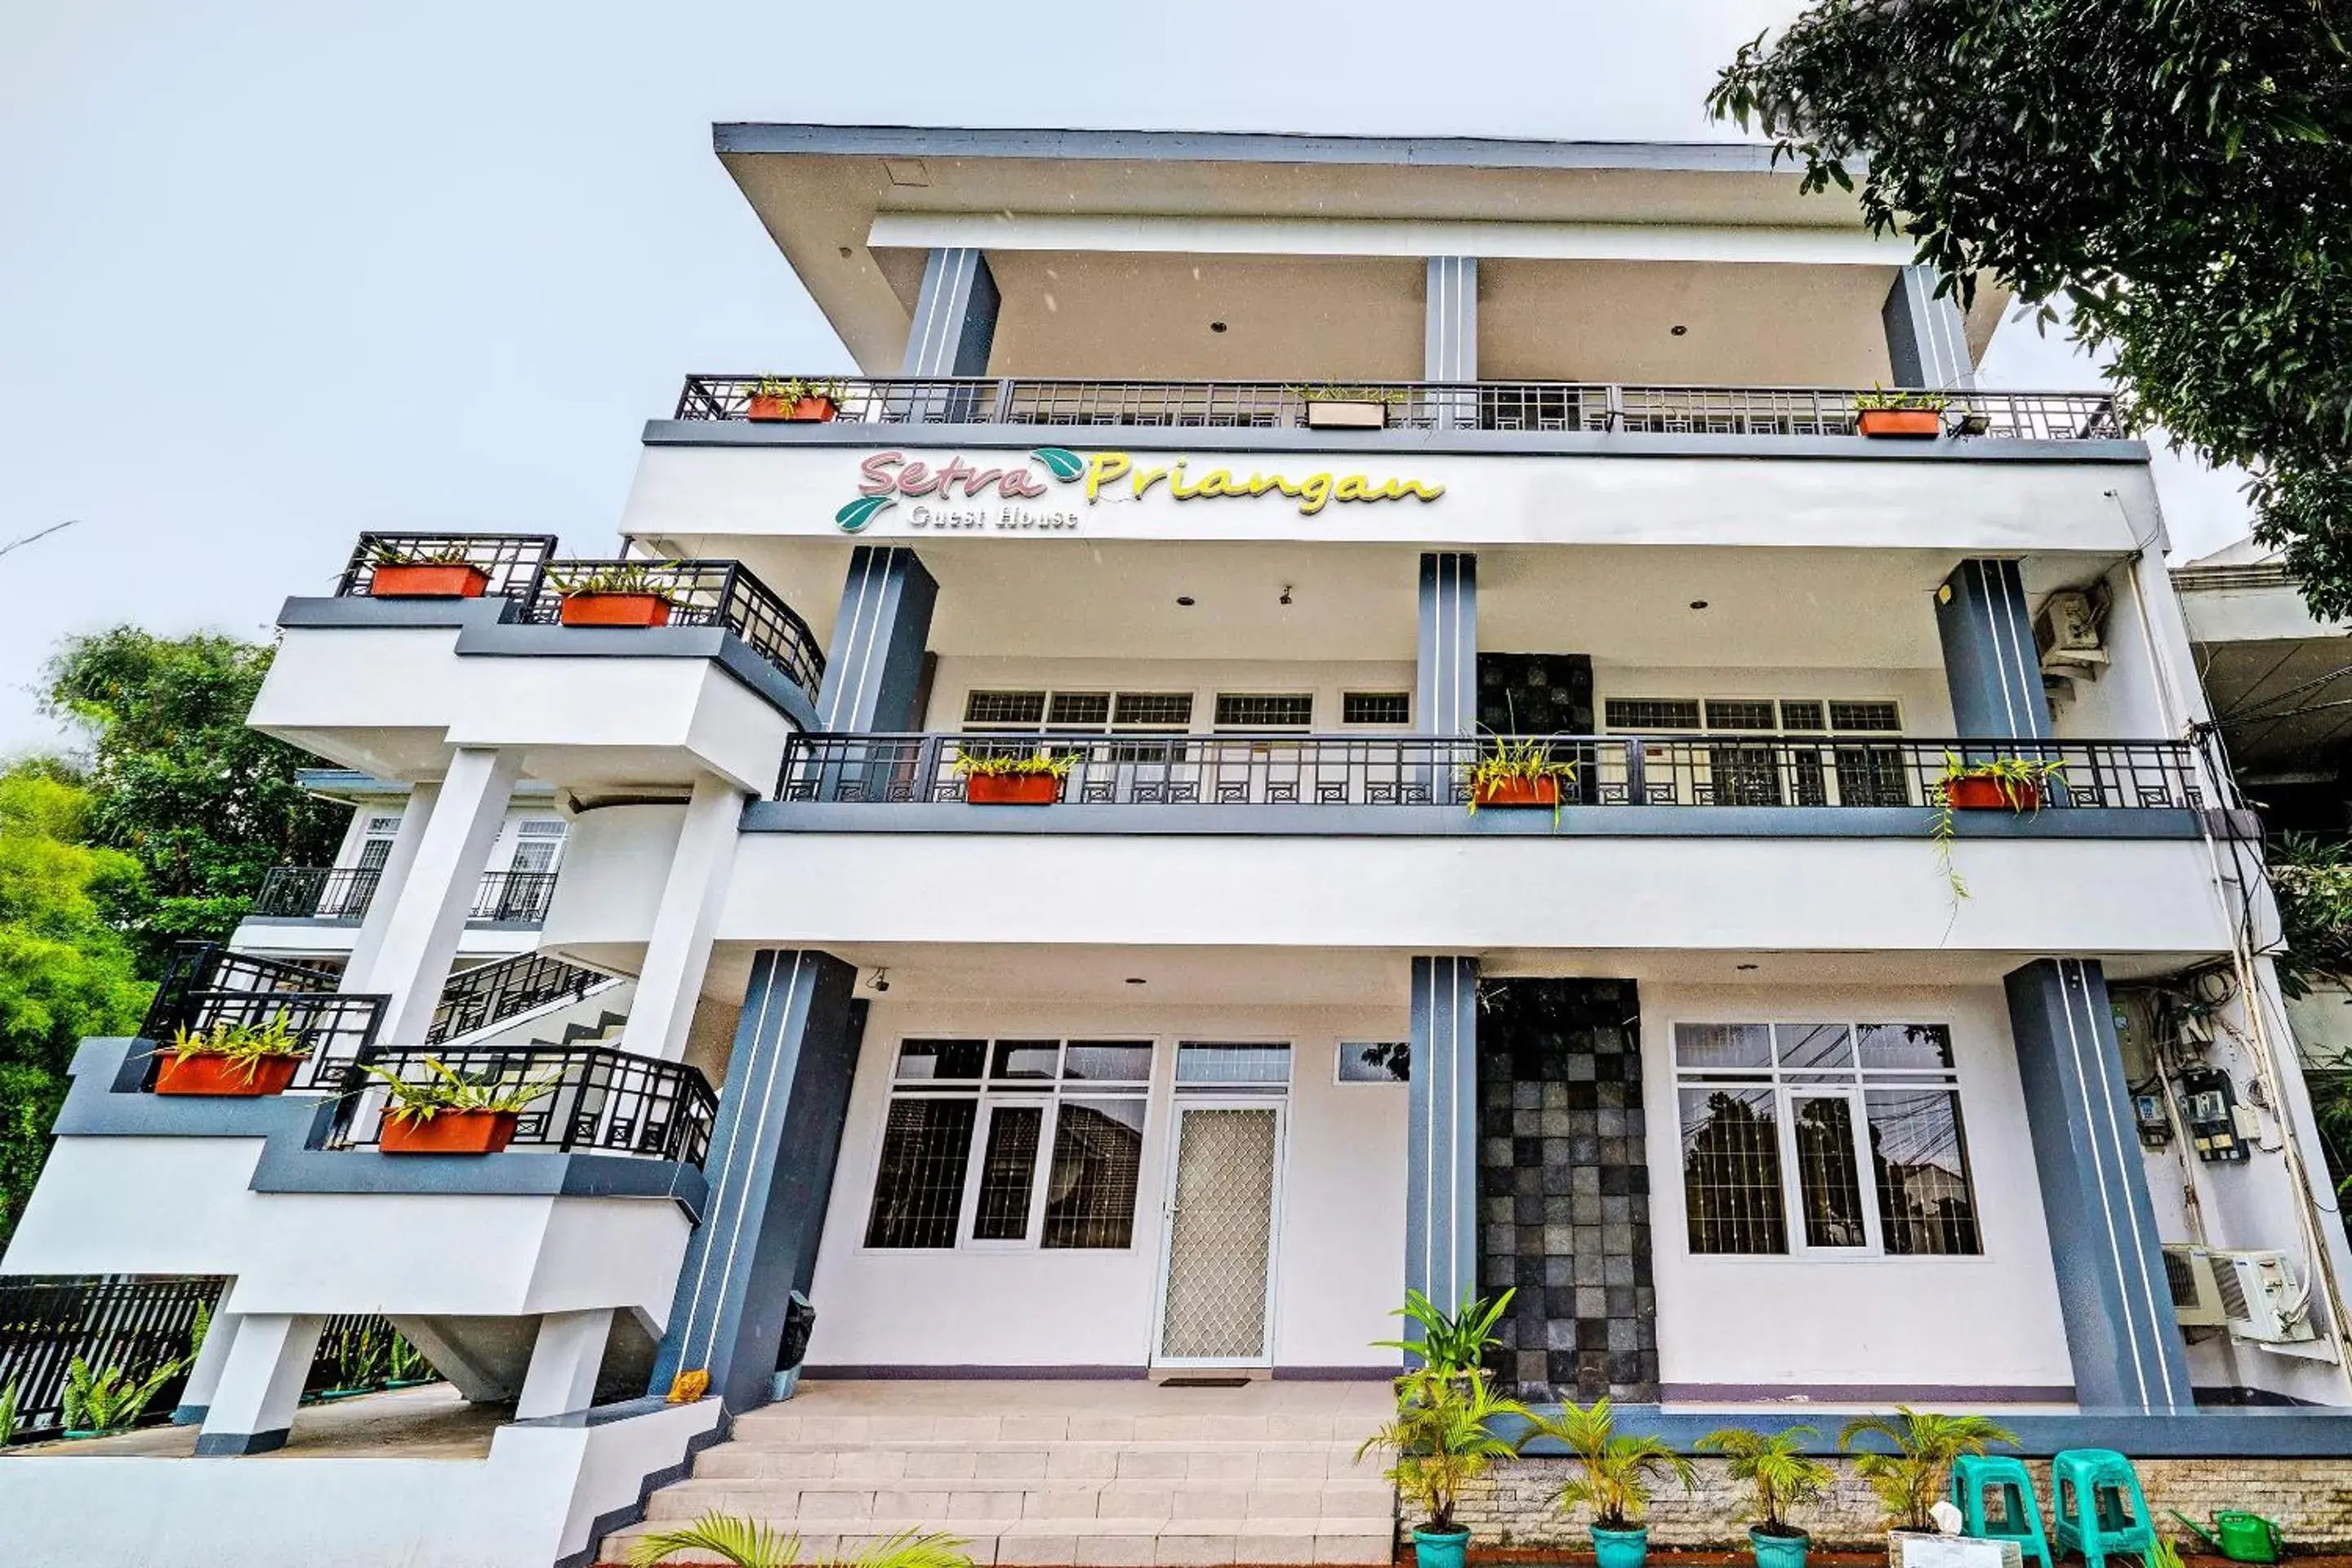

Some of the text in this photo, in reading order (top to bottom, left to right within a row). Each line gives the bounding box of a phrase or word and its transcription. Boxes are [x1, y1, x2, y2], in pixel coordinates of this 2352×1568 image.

[858, 451, 1446, 515] Setra Priangan
[908, 505, 1078, 529] Guest House
